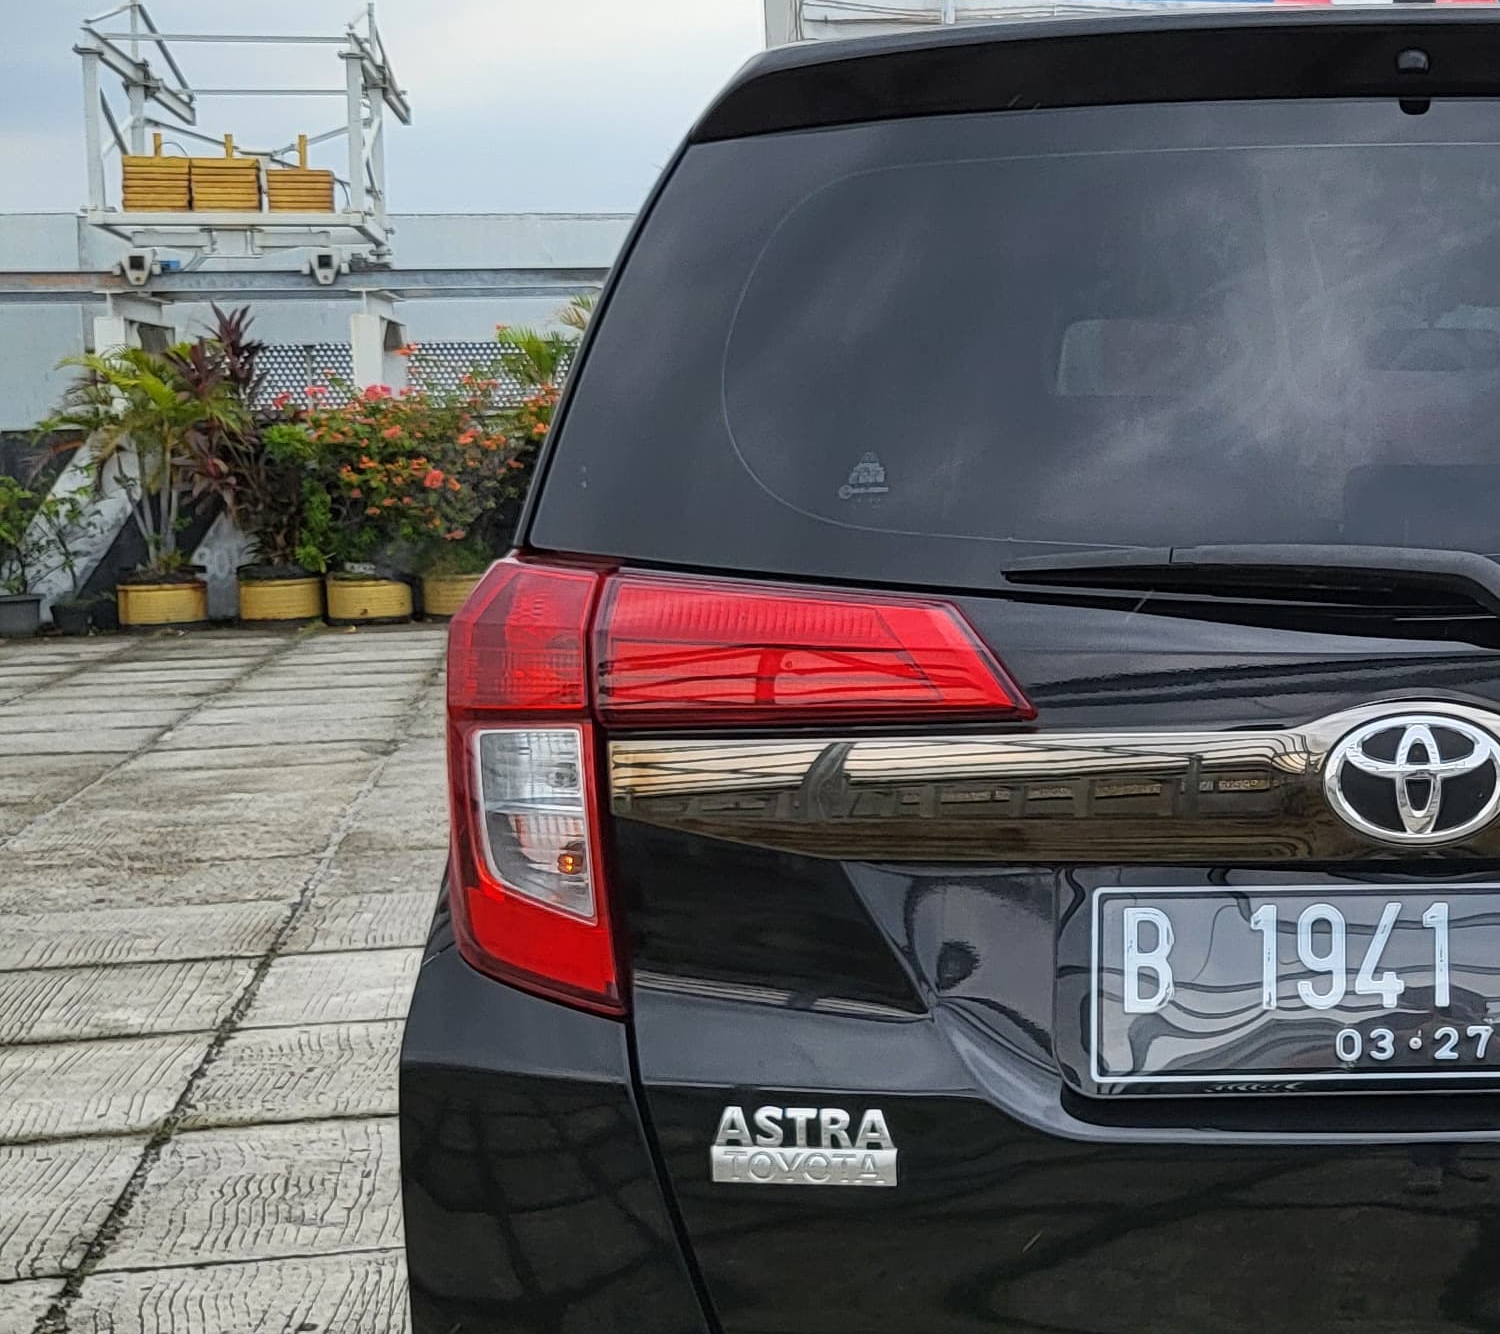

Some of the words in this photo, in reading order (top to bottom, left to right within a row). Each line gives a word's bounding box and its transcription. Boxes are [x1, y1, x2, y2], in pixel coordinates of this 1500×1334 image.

[1123, 906, 1175, 1014] B
[1250, 901, 1451, 1010] 1941
[714, 1105, 896, 1150] ASTRA
[723, 1149, 886, 1186] TOYOTA
